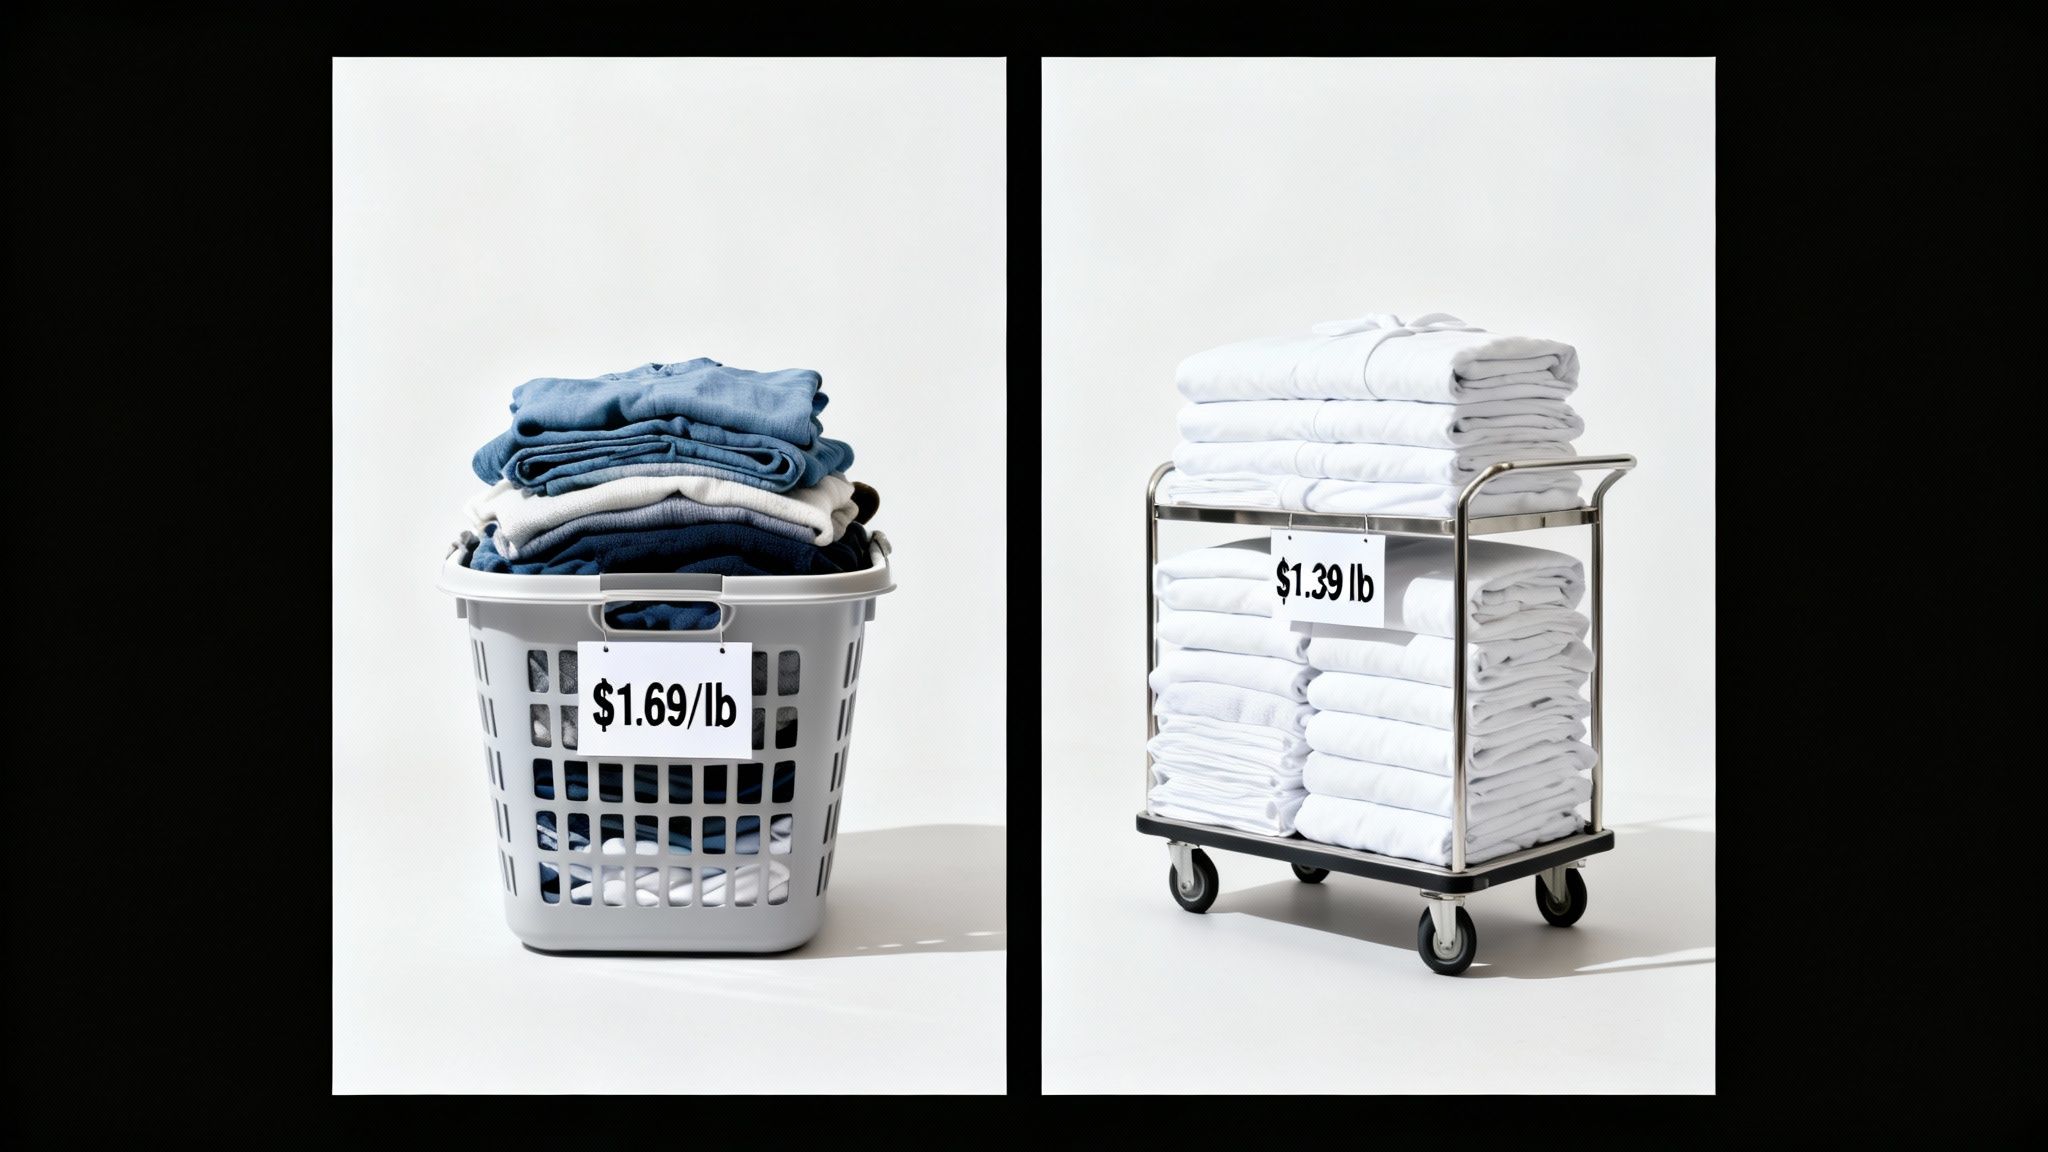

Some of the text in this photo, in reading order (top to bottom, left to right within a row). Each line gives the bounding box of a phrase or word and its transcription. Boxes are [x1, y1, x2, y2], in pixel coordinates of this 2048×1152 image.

[1276, 556, 1374, 605] $1.39 lb
[592, 677, 737, 733] $1.69/lb
